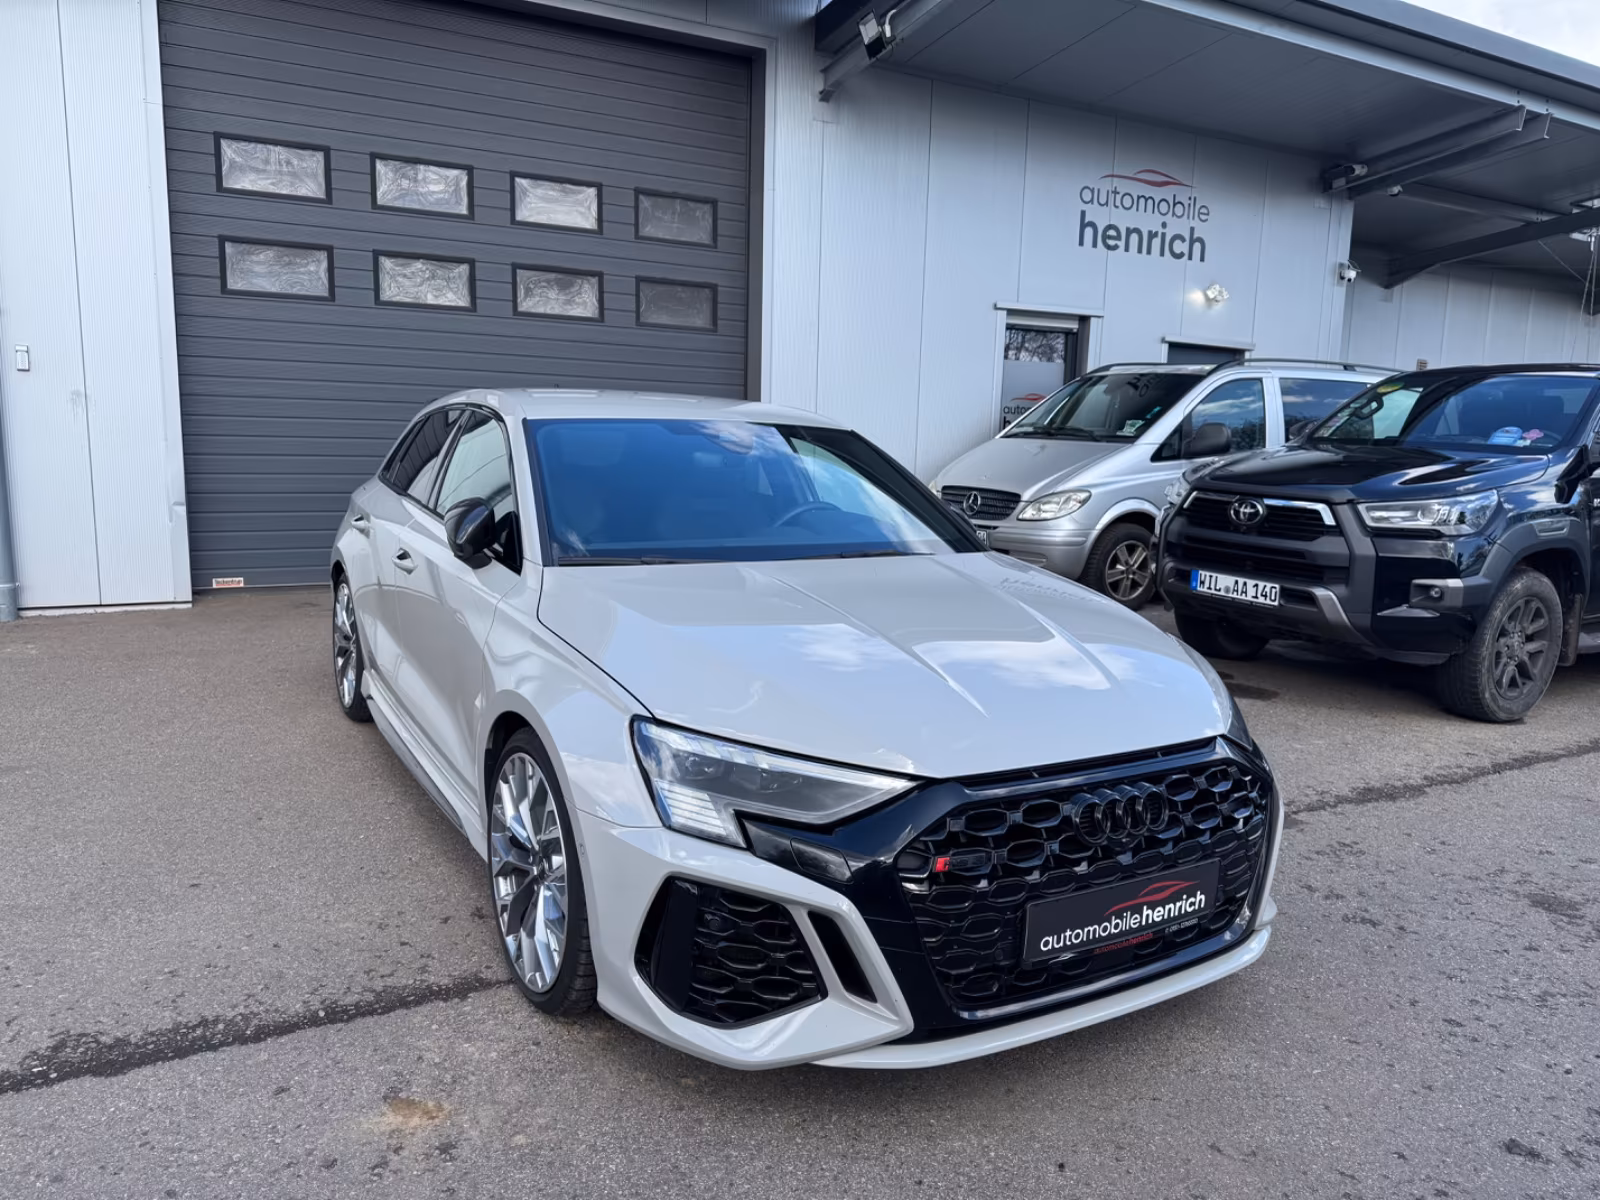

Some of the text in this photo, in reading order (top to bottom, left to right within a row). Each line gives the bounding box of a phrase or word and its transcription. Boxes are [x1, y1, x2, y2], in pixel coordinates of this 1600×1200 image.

[1079, 185, 1210, 223] automobile
[1078, 209, 1206, 263] henrich
[1199, 572, 1278, 602] WIL AA 140
